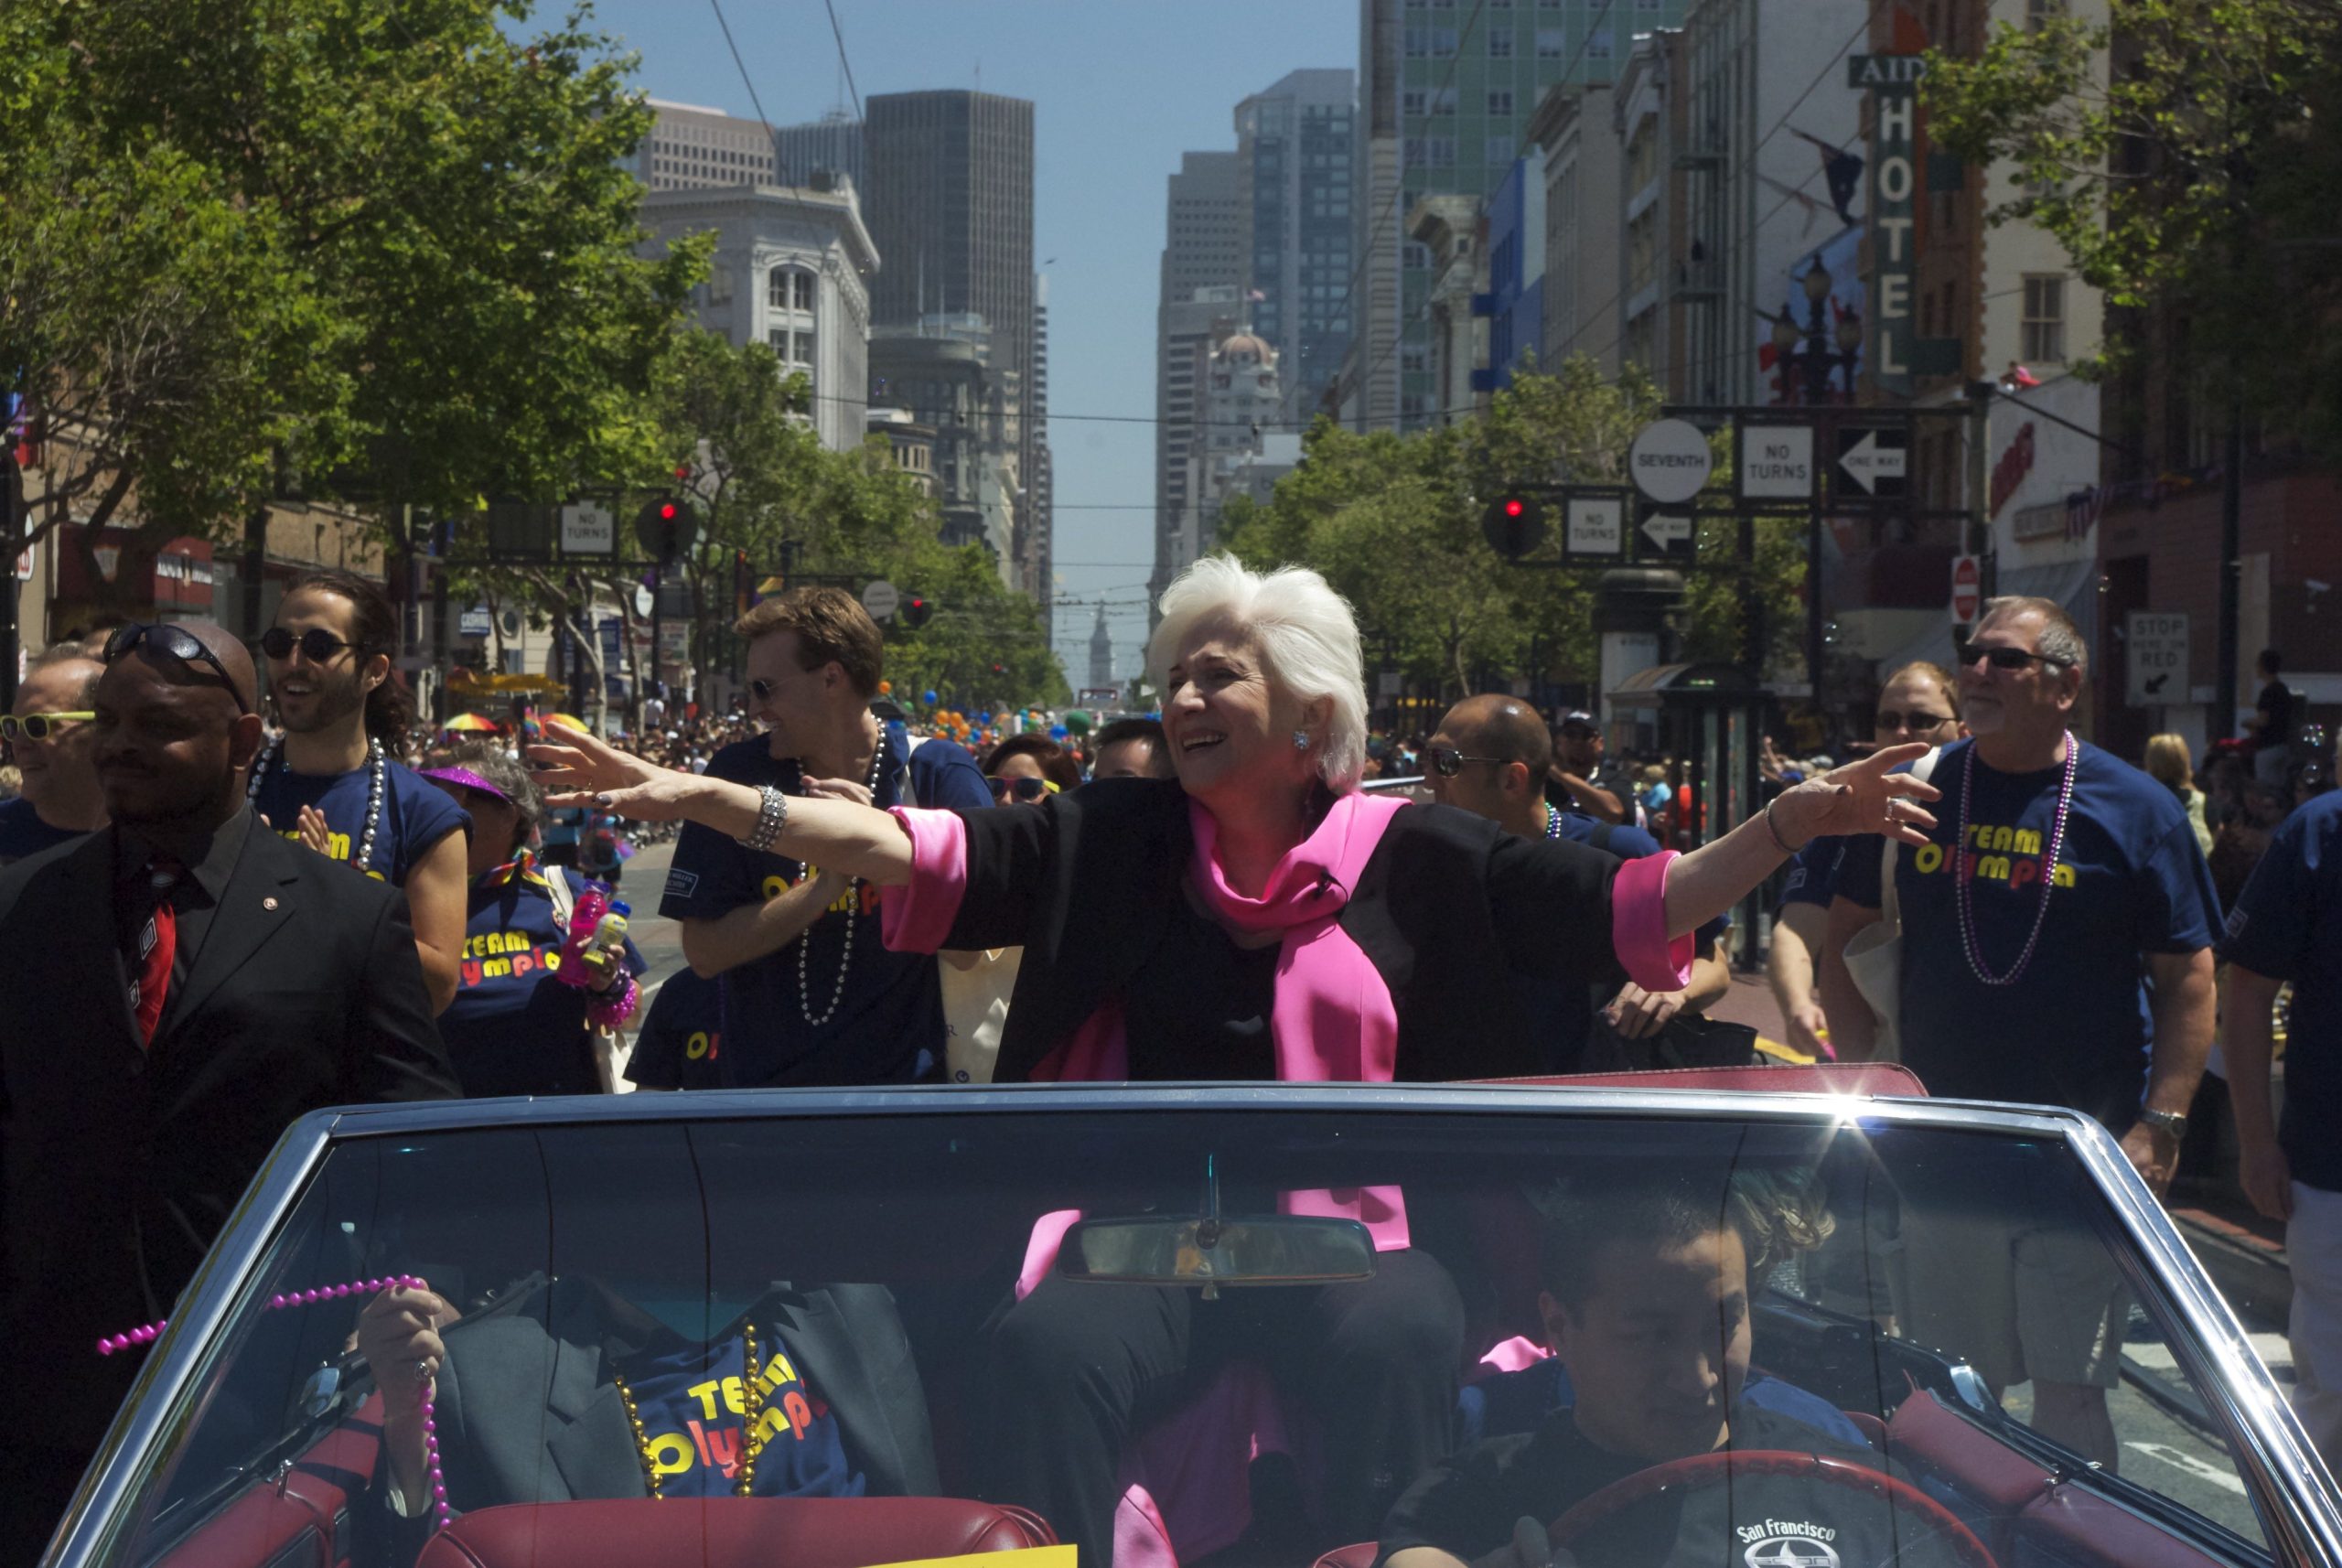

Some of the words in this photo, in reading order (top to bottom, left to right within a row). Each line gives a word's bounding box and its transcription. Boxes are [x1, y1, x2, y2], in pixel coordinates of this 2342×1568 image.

[1878, 97, 1915, 376] HOTEL
[1765, 445, 1790, 459] NO
[1638, 454, 1704, 468] SEVENTH
[1847, 456, 1871, 467] ONE
[1748, 464, 1808, 480] TURNS
[578, 512, 597, 525] NO
[1585, 513, 1605, 526] NO
[567, 527, 608, 540] TURNS
[1574, 528, 1617, 541] TURNS
[2135, 619, 2185, 636] STOP
[2140, 651, 2178, 668] RED
[1736, 1524, 1767, 1544] San
[1765, 1518, 1837, 1542] Francisco
